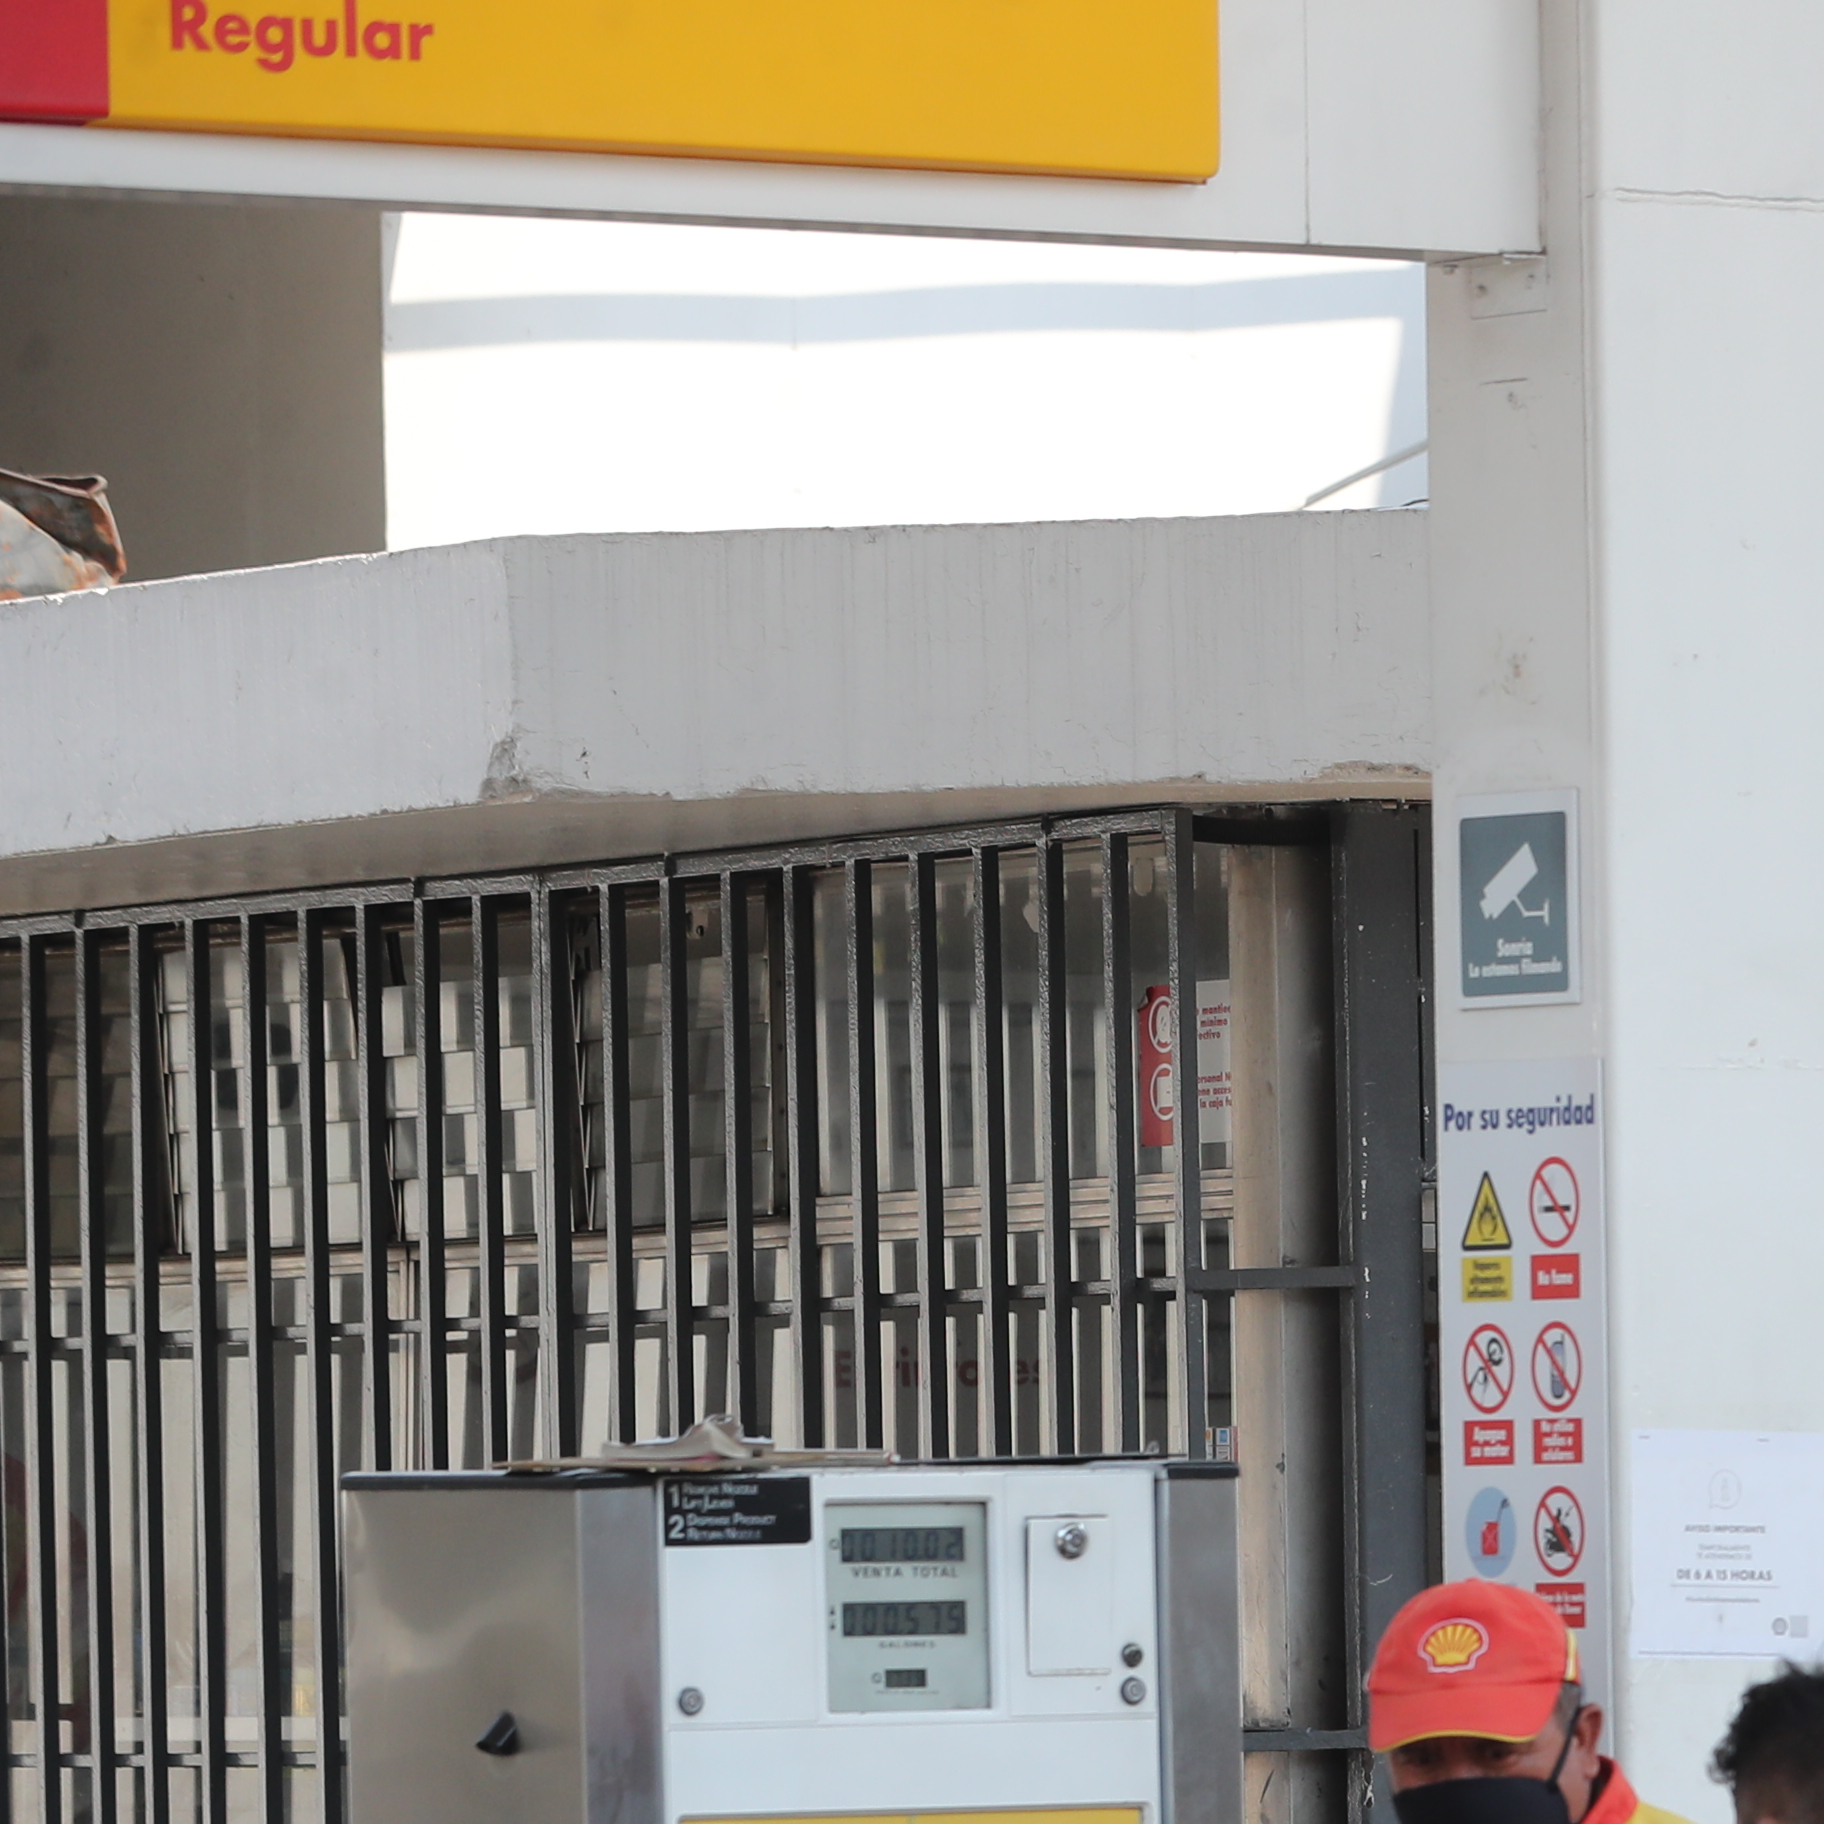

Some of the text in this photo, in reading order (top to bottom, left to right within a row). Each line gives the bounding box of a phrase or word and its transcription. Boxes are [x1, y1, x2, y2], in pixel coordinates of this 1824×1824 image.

[169, 0, 435, 72] Regular
[1443, 1093, 1595, 1135] Por su seguridad
[668, 1484, 680, 1508] 1
[668, 1514, 685, 1540] 2
[852, 1565, 959, 1579] VENTA TOTAL
[1730, 1569, 1774, 1582] HORAS
